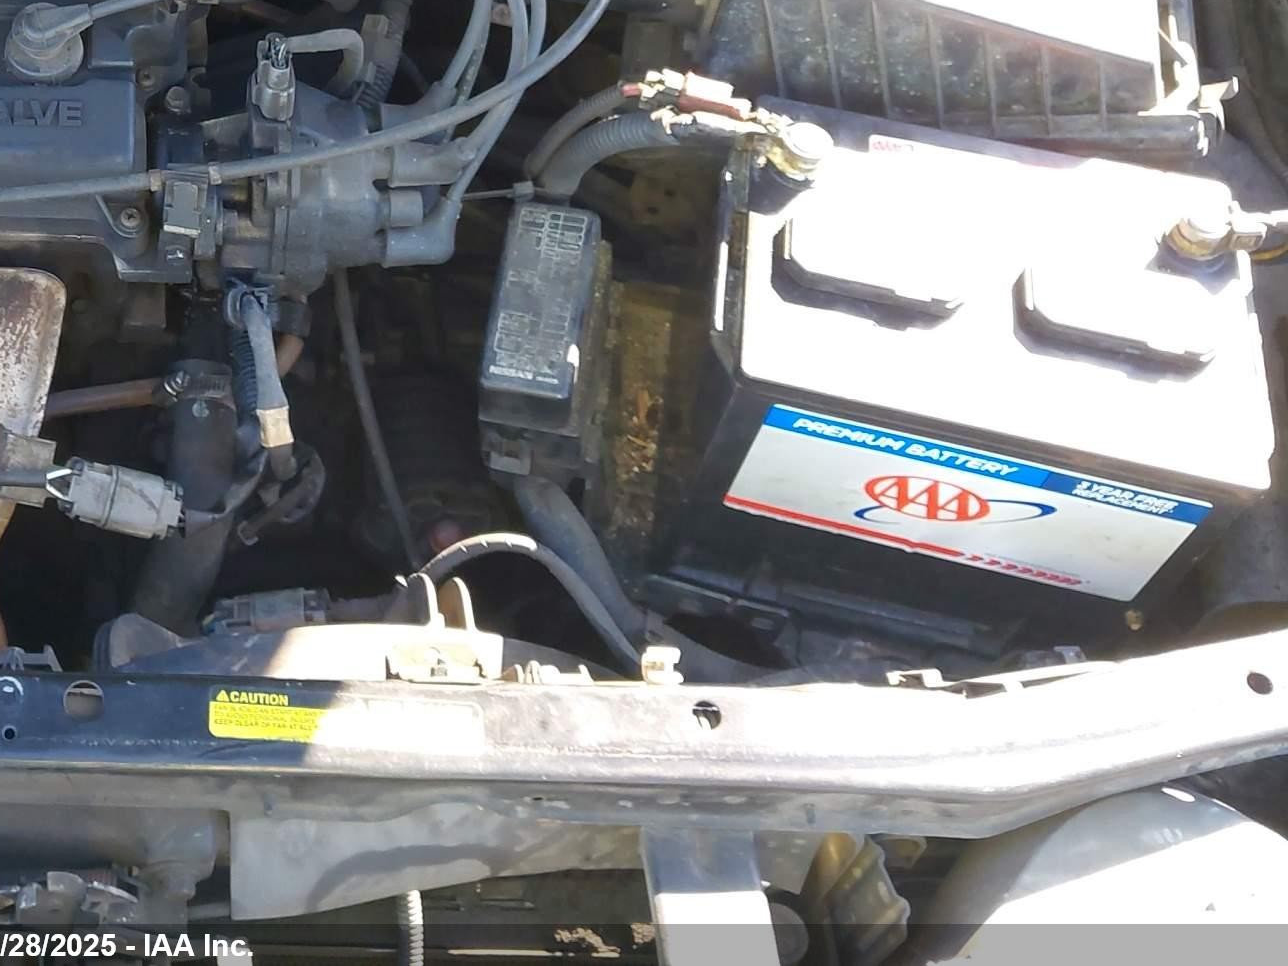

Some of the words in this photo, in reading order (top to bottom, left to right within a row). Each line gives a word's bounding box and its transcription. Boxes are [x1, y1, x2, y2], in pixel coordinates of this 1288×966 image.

[793, 417, 905, 451] PREMIUM
[905, 444, 1019, 476] BATTERY
[877, 476, 970, 522] AAA
[1091, 484, 1134, 499] YEAR
[230, 691, 288, 706] CAUTION
